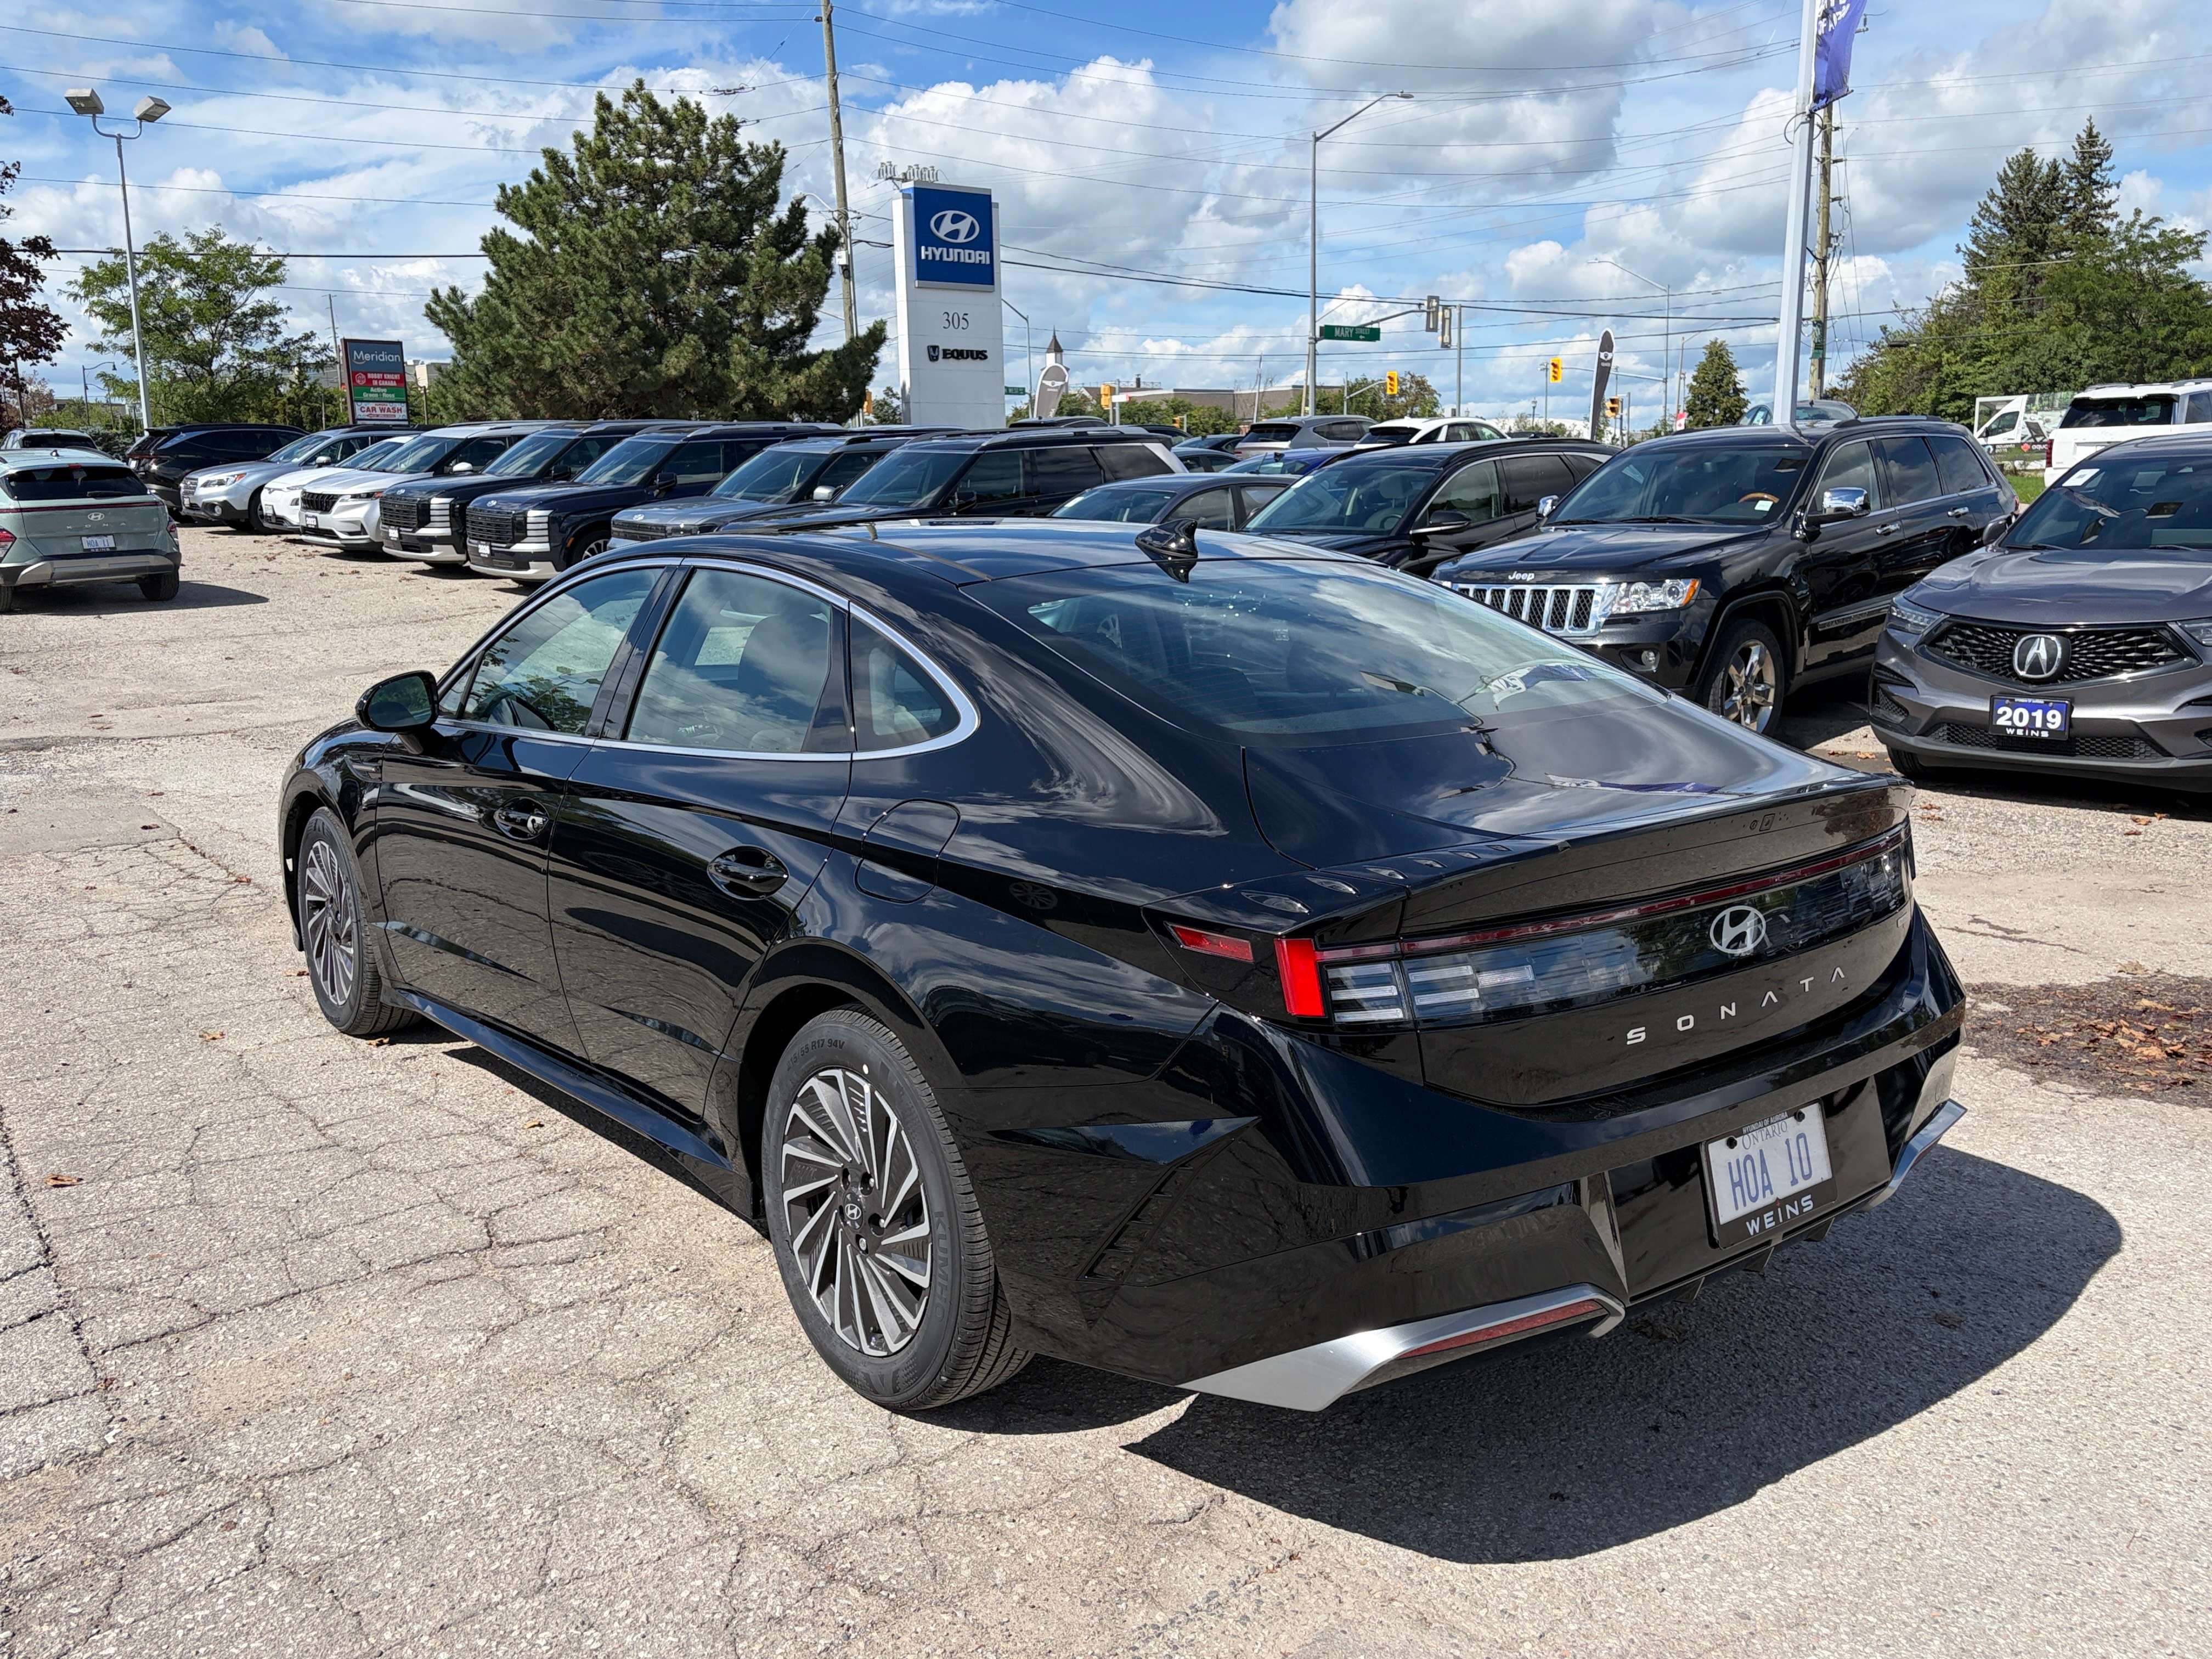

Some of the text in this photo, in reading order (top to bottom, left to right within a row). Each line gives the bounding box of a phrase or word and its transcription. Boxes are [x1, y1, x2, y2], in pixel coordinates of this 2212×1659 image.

[921, 246, 990, 264] HYUNDAI
[943, 312, 969, 330] 305
[1335, 327, 1354, 337] MARY
[353, 350, 400, 362] Meridian
[942, 349, 988, 360] EQUUS
[1508, 571, 1535, 582] Jeep
[1996, 706, 2062, 730] 2019
[2006, 727, 2050, 737] WEINS
[1627, 967, 1846, 1045] SONATA
[827, 1039, 845, 1049] 94V
[1742, 1111, 1788, 1134] HYUNDAI OF AURORA
[1742, 1121, 1787, 1150] ONTARIO
[1728, 1133, 1813, 1211] HOA 10
[1746, 1194, 1814, 1235] WEINS
